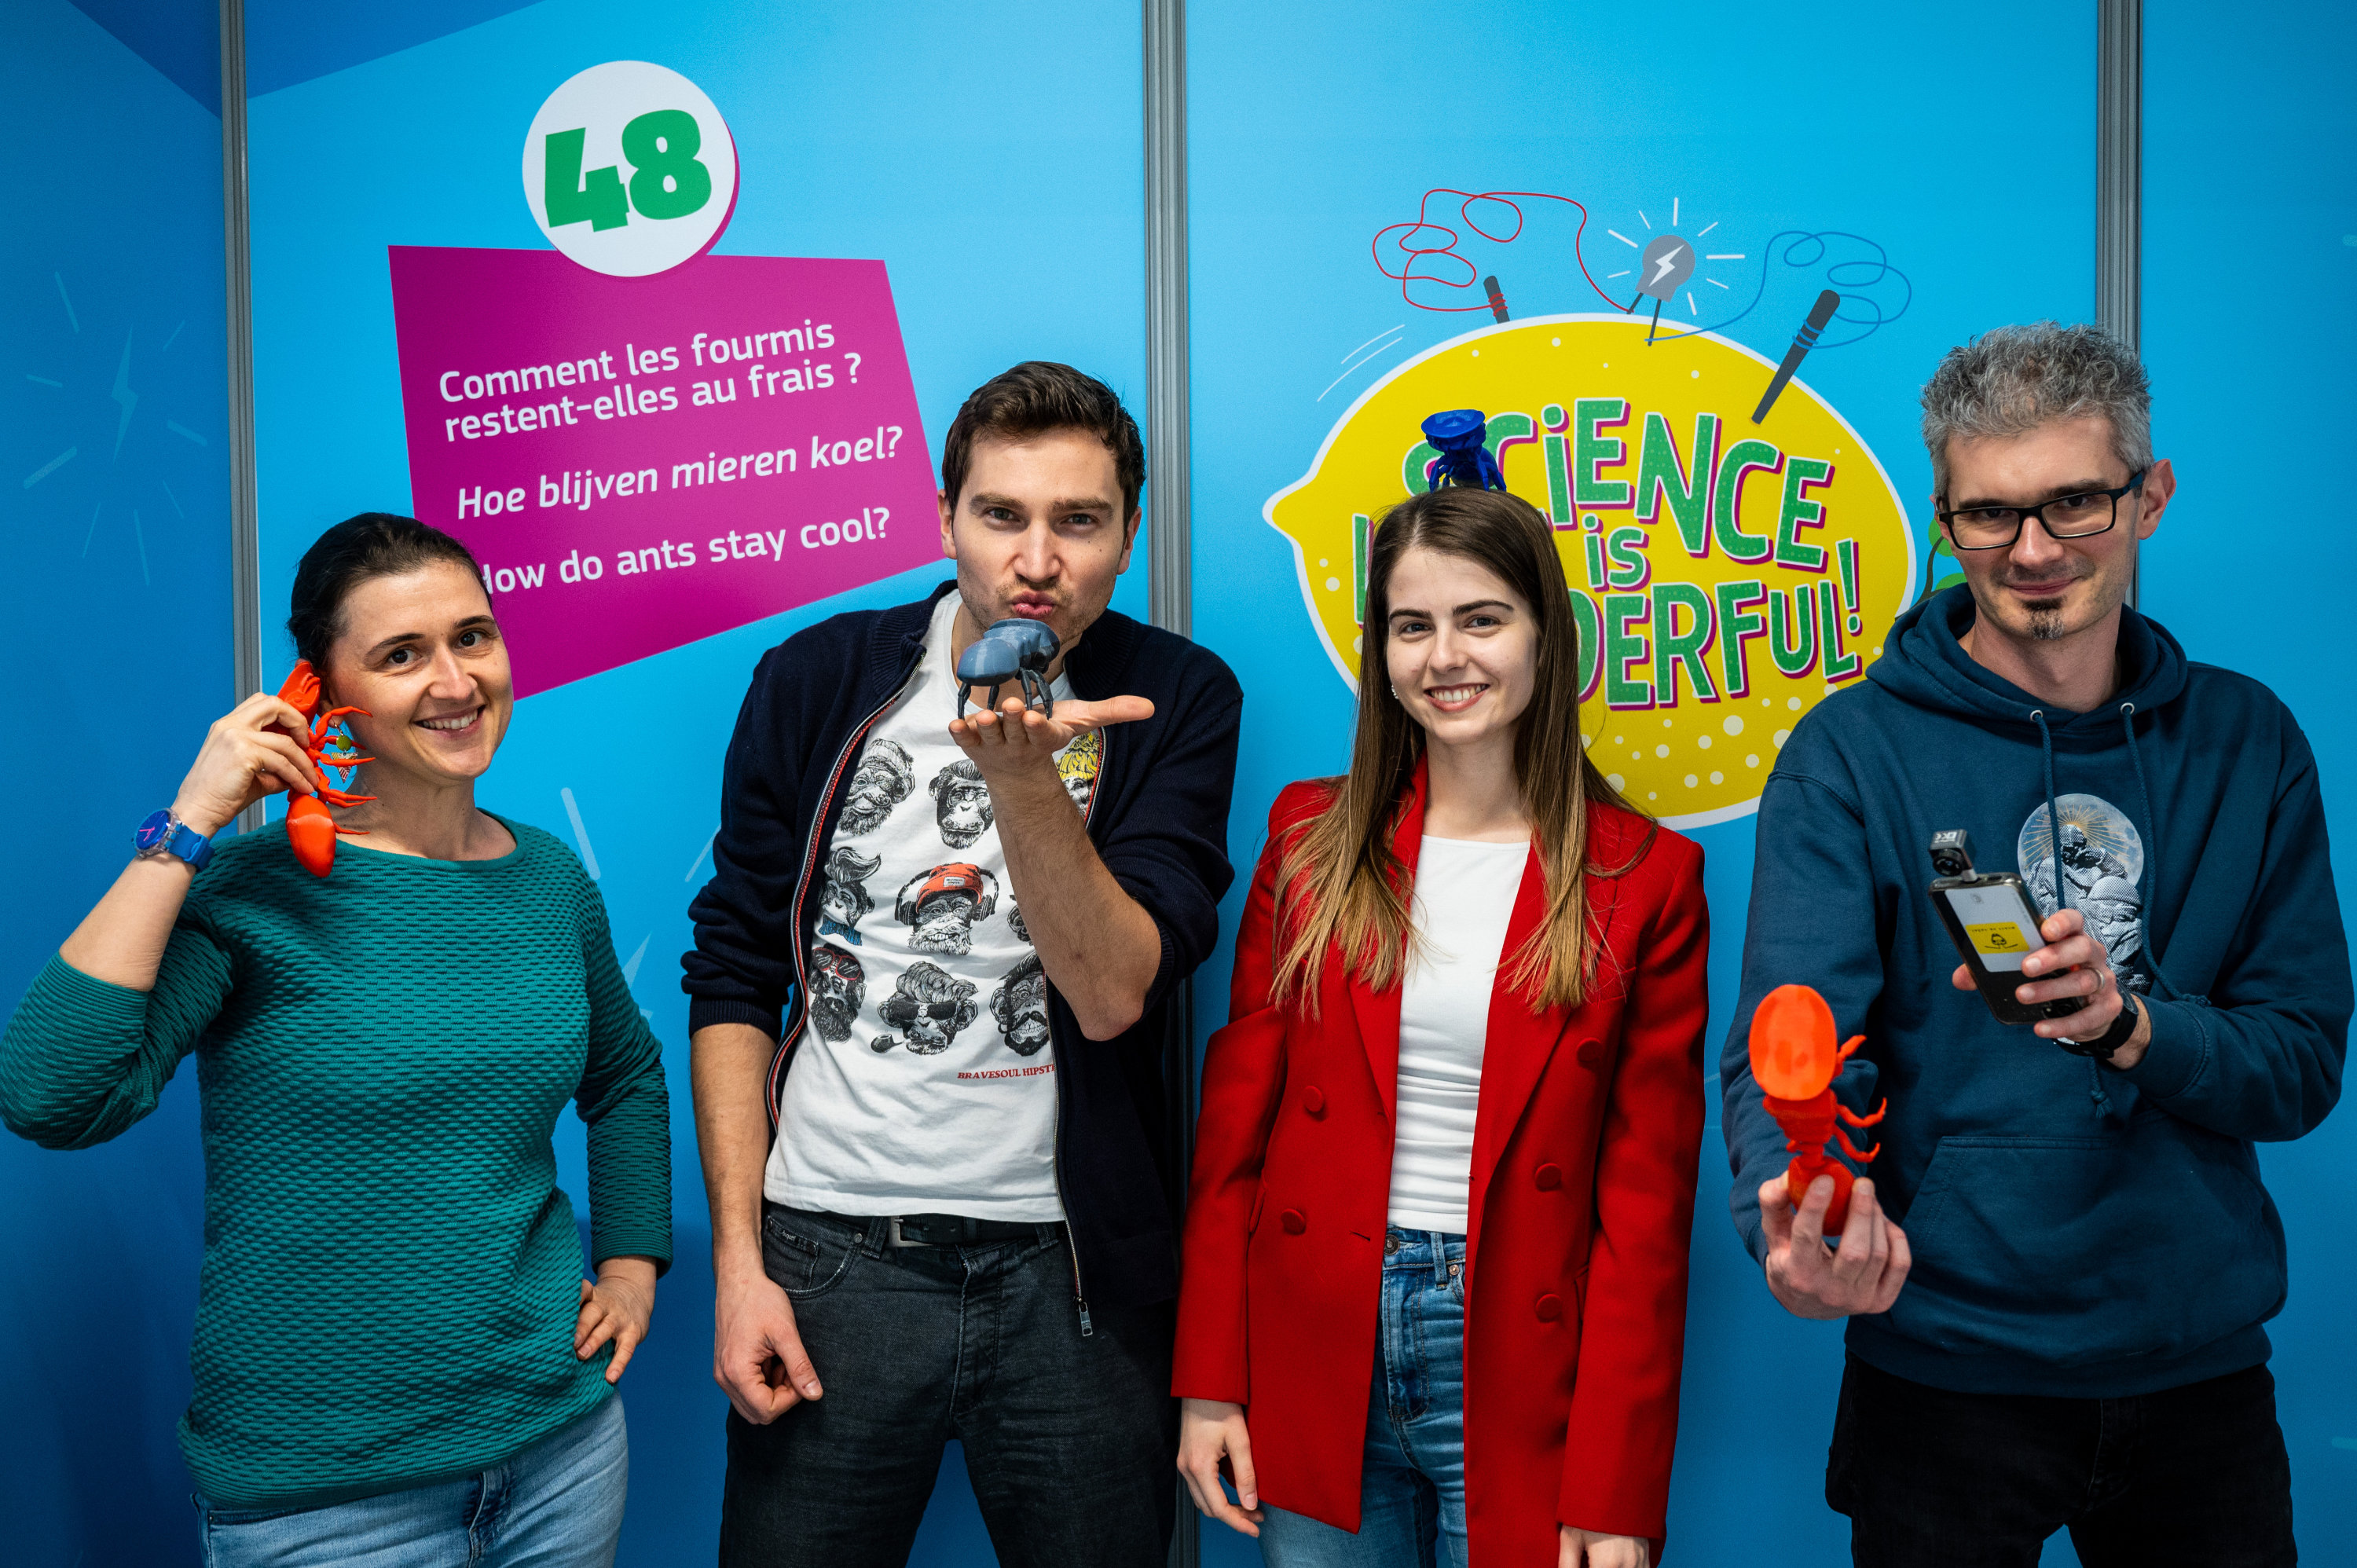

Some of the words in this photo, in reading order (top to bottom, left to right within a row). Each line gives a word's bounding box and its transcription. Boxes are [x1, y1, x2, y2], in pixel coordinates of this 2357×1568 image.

[544, 109, 712, 232] 48
[439, 351, 617, 402] Comment
[626, 343, 680, 376] les
[691, 318, 835, 367] fourmis
[445, 383, 680, 442] restent-elles
[692, 378, 736, 407] au
[747, 359, 834, 398] frais
[844, 352, 862, 384] ?
[458, 485, 526, 519] Hoe
[539, 467, 658, 511] blijven
[672, 448, 797, 489] mieren
[811, 425, 903, 469] koel?
[559, 549, 603, 584] do
[617, 540, 696, 576] ants
[709, 529, 786, 562] stay
[800, 507, 890, 549] cool?
[957, 1068, 1021, 1079] BRAVESOUL
